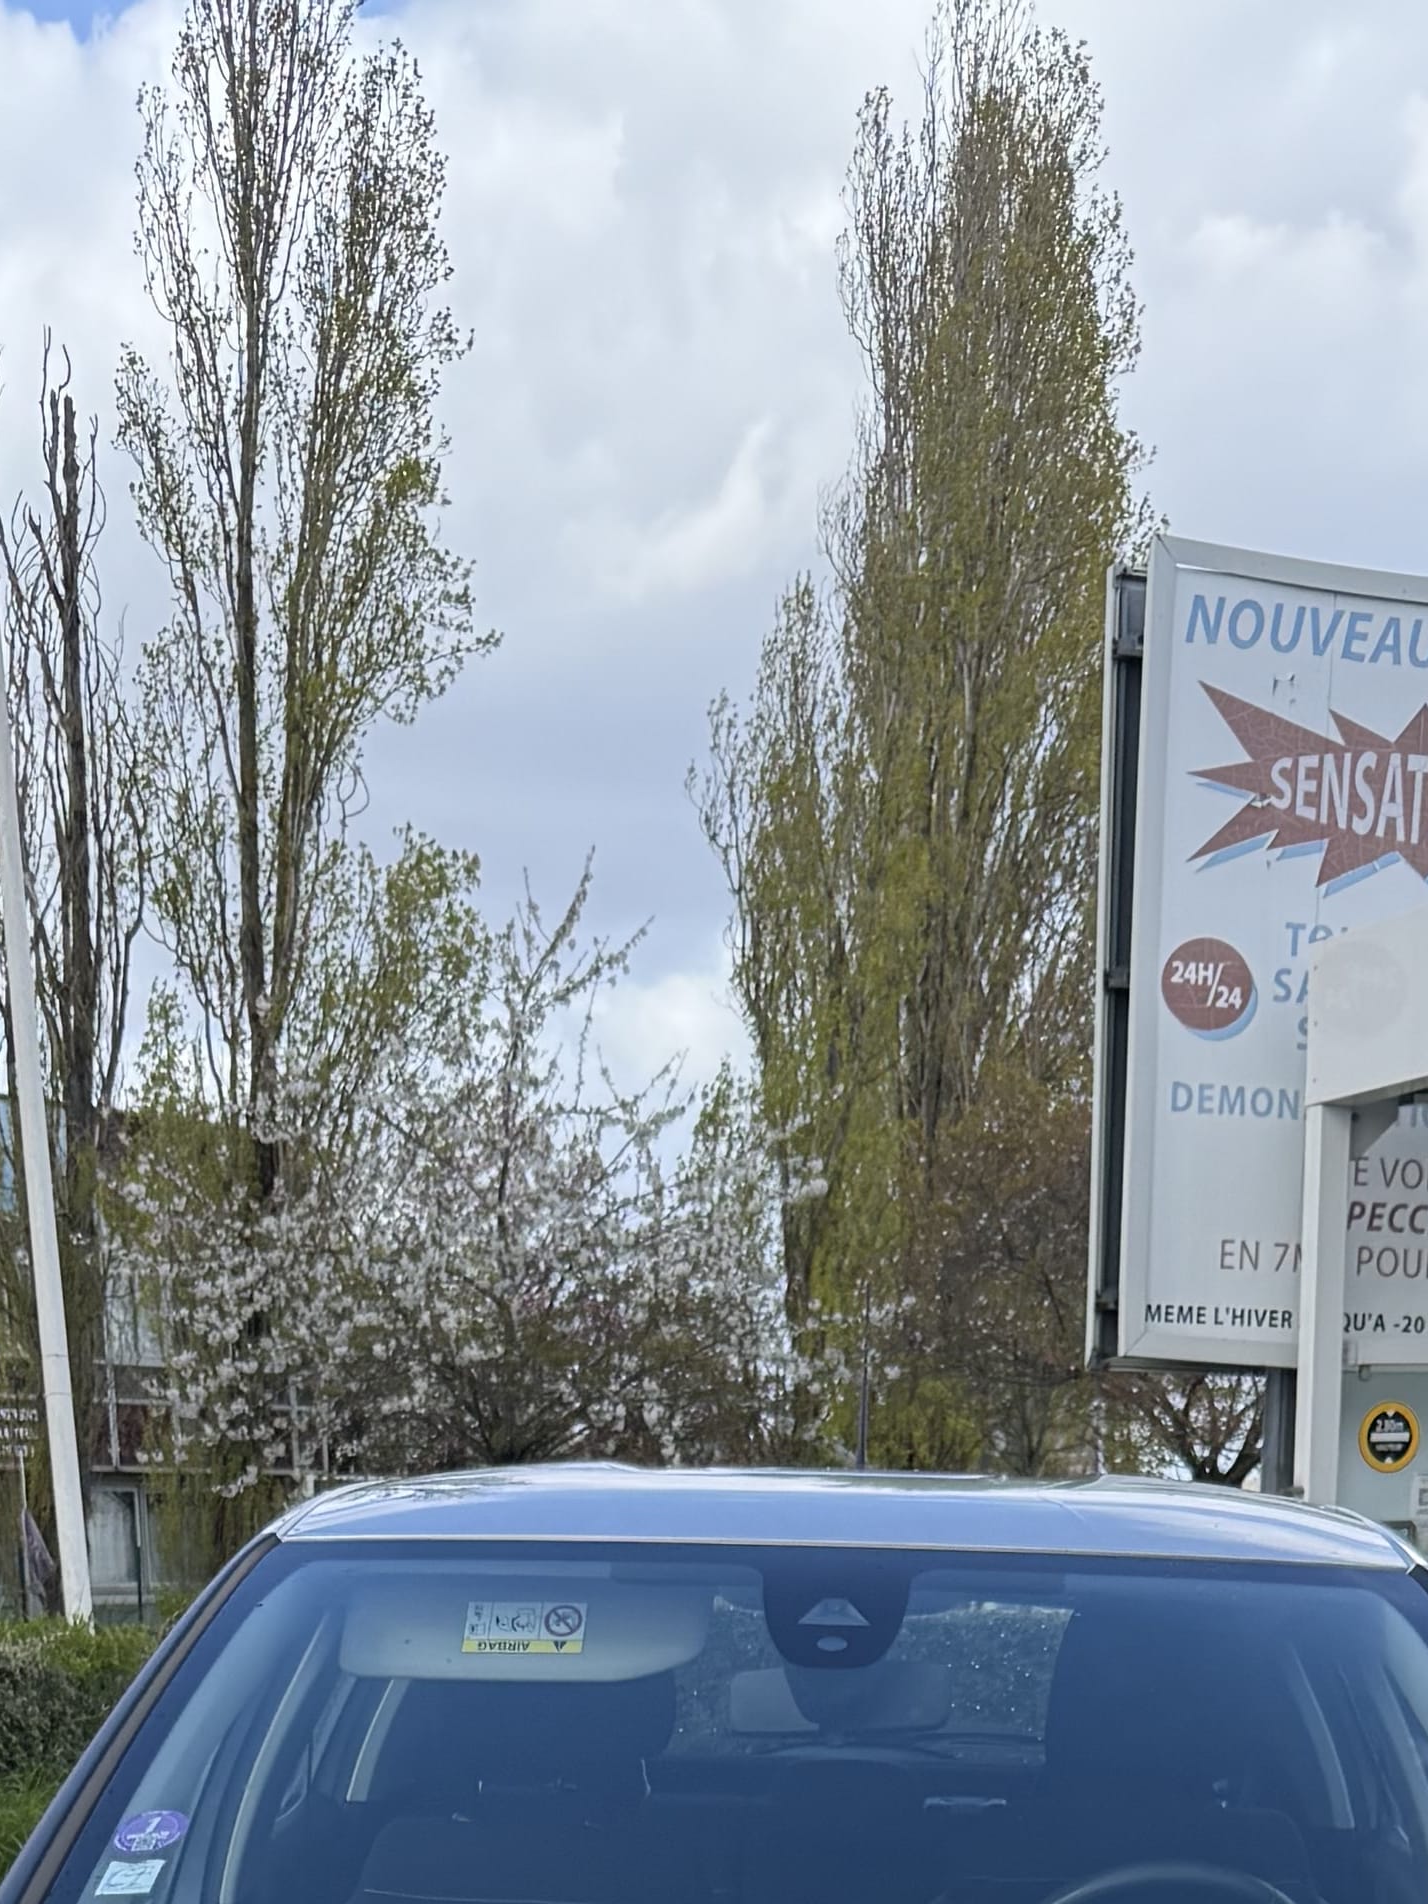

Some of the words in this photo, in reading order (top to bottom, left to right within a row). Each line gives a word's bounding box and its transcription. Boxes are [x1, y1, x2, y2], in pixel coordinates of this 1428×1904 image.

[1220, 1239, 1260, 1271] EN
[1144, 1304, 1207, 1325] MEME
[1214, 1306, 1293, 1329] L'HIVER
[477, 1640, 530, 1651] AIRBAG
